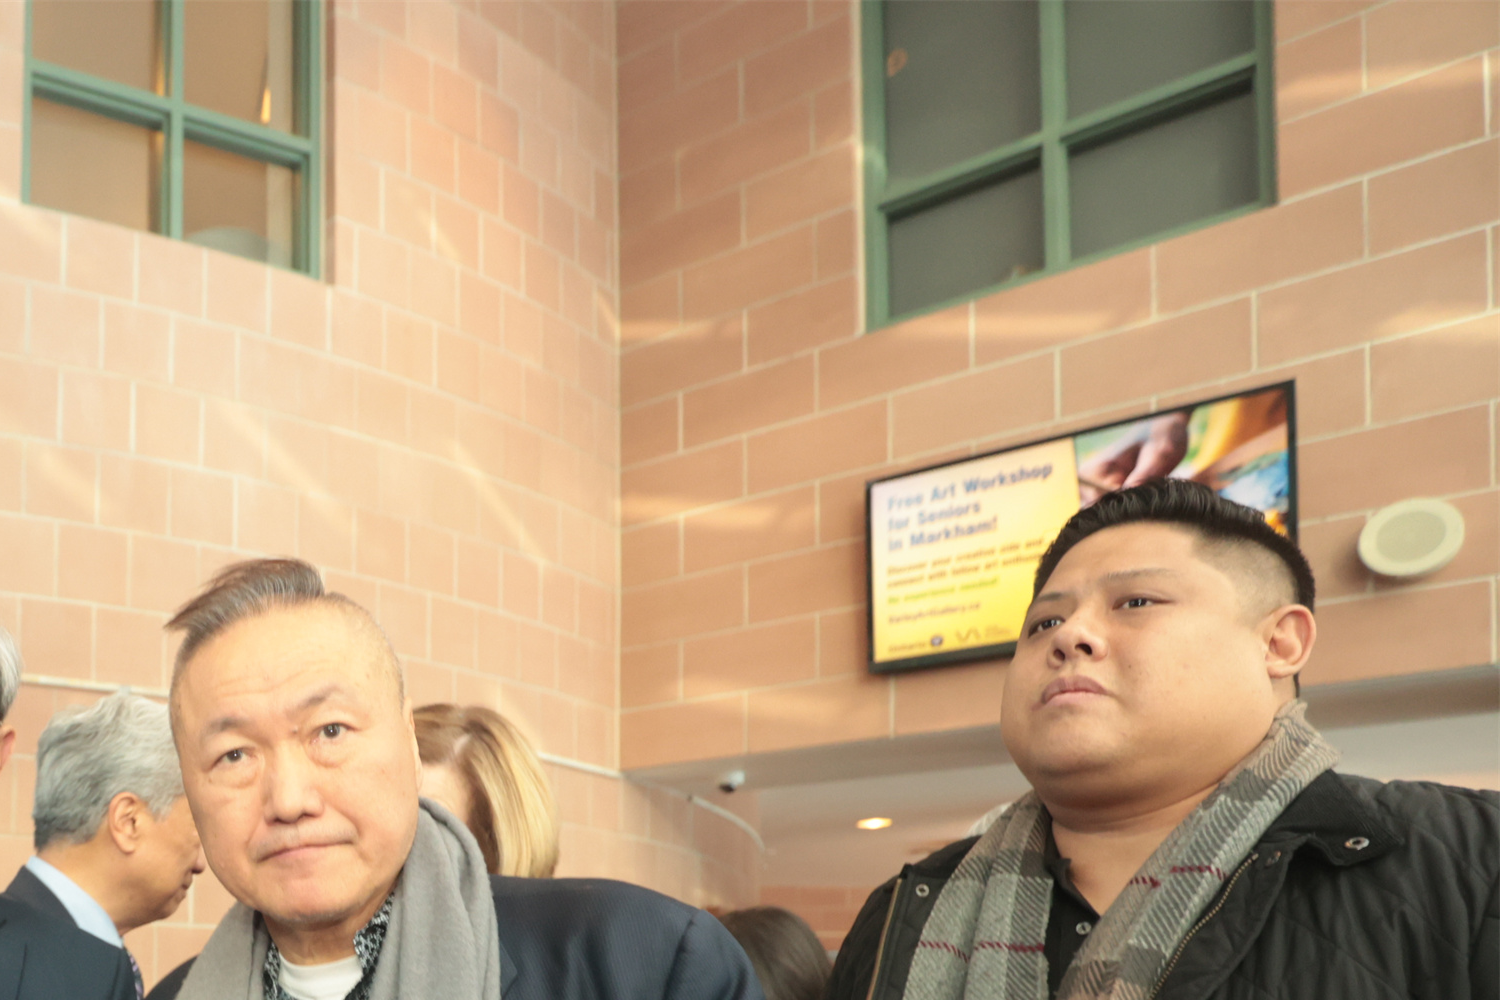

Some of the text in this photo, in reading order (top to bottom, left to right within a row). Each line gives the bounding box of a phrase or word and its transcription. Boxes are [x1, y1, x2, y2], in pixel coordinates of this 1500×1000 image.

[888, 464, 1052, 511] Free Art Workshop
[888, 502, 980, 531] for Seniors
[888, 516, 997, 552] in Markham!
